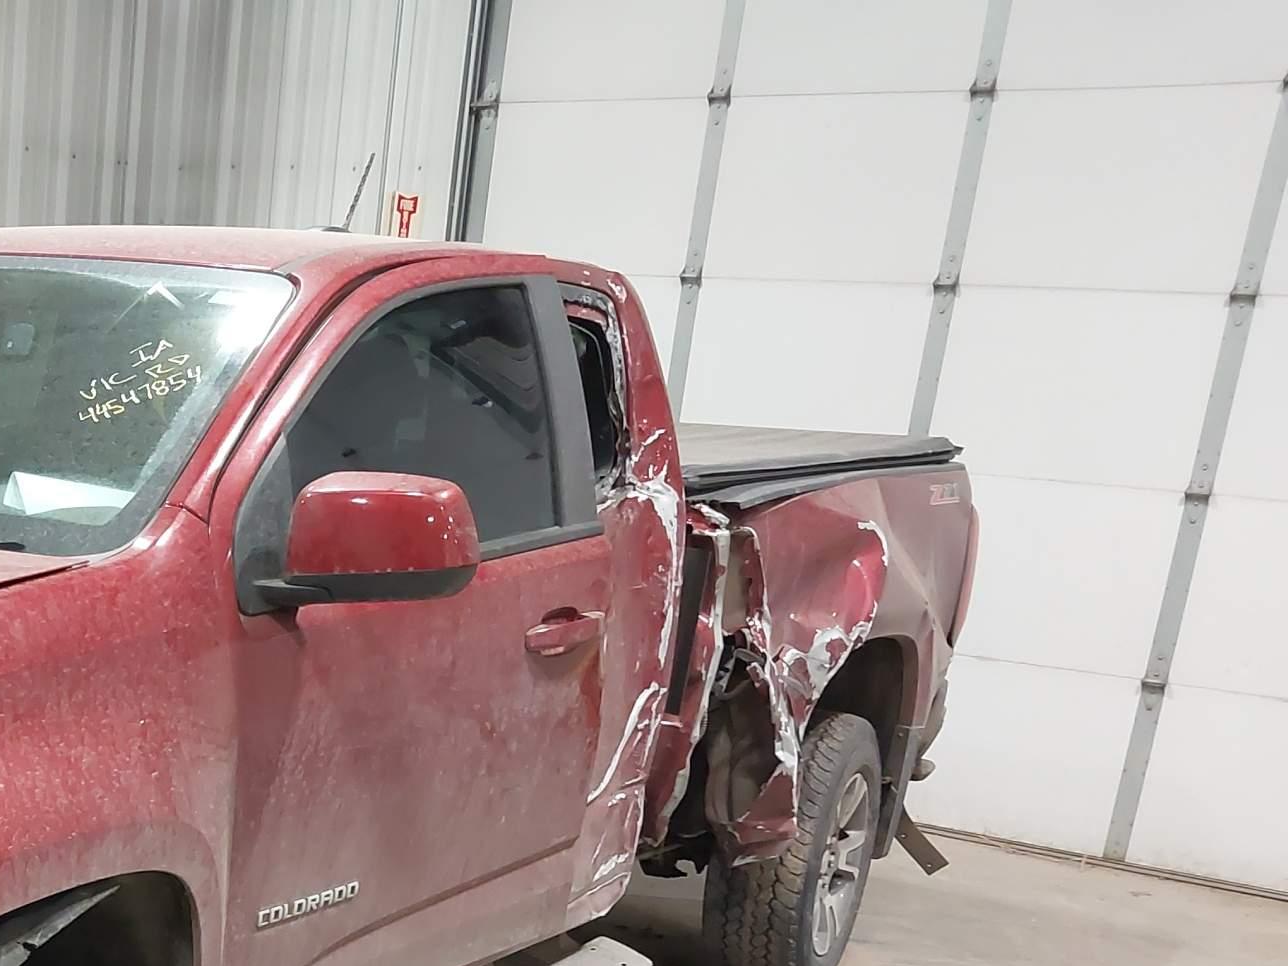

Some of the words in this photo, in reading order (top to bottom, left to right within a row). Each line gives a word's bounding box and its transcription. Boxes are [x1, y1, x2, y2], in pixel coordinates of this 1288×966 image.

[129, 339, 174, 368] IA
[78, 365, 201, 423] 44547854
[256, 880, 360, 928] COLORADO
